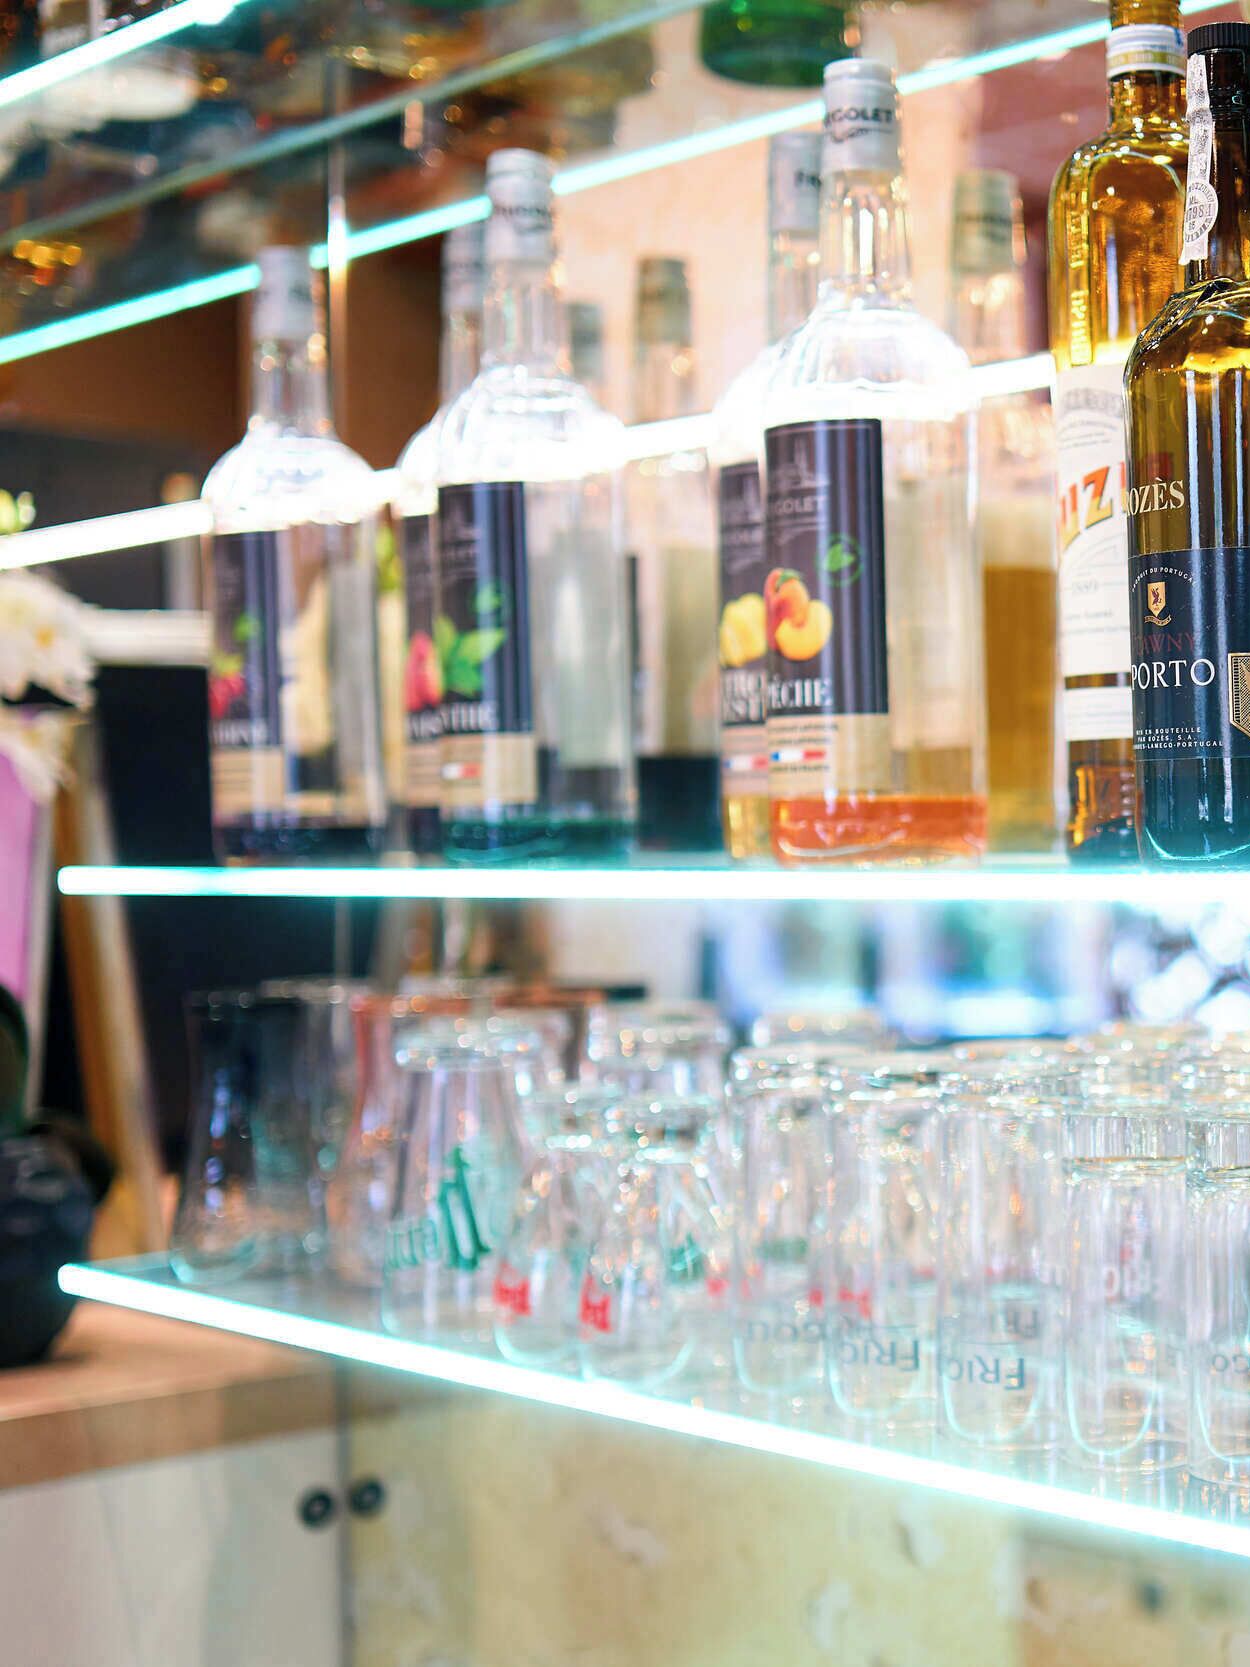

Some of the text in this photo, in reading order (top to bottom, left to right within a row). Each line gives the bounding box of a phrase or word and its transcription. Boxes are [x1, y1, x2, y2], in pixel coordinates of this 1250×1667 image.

[1055, 462, 1127, 552] UZ
[1131, 658, 1216, 691] PORTO
[1155, 727, 1202, 735] BOUTEILLE
